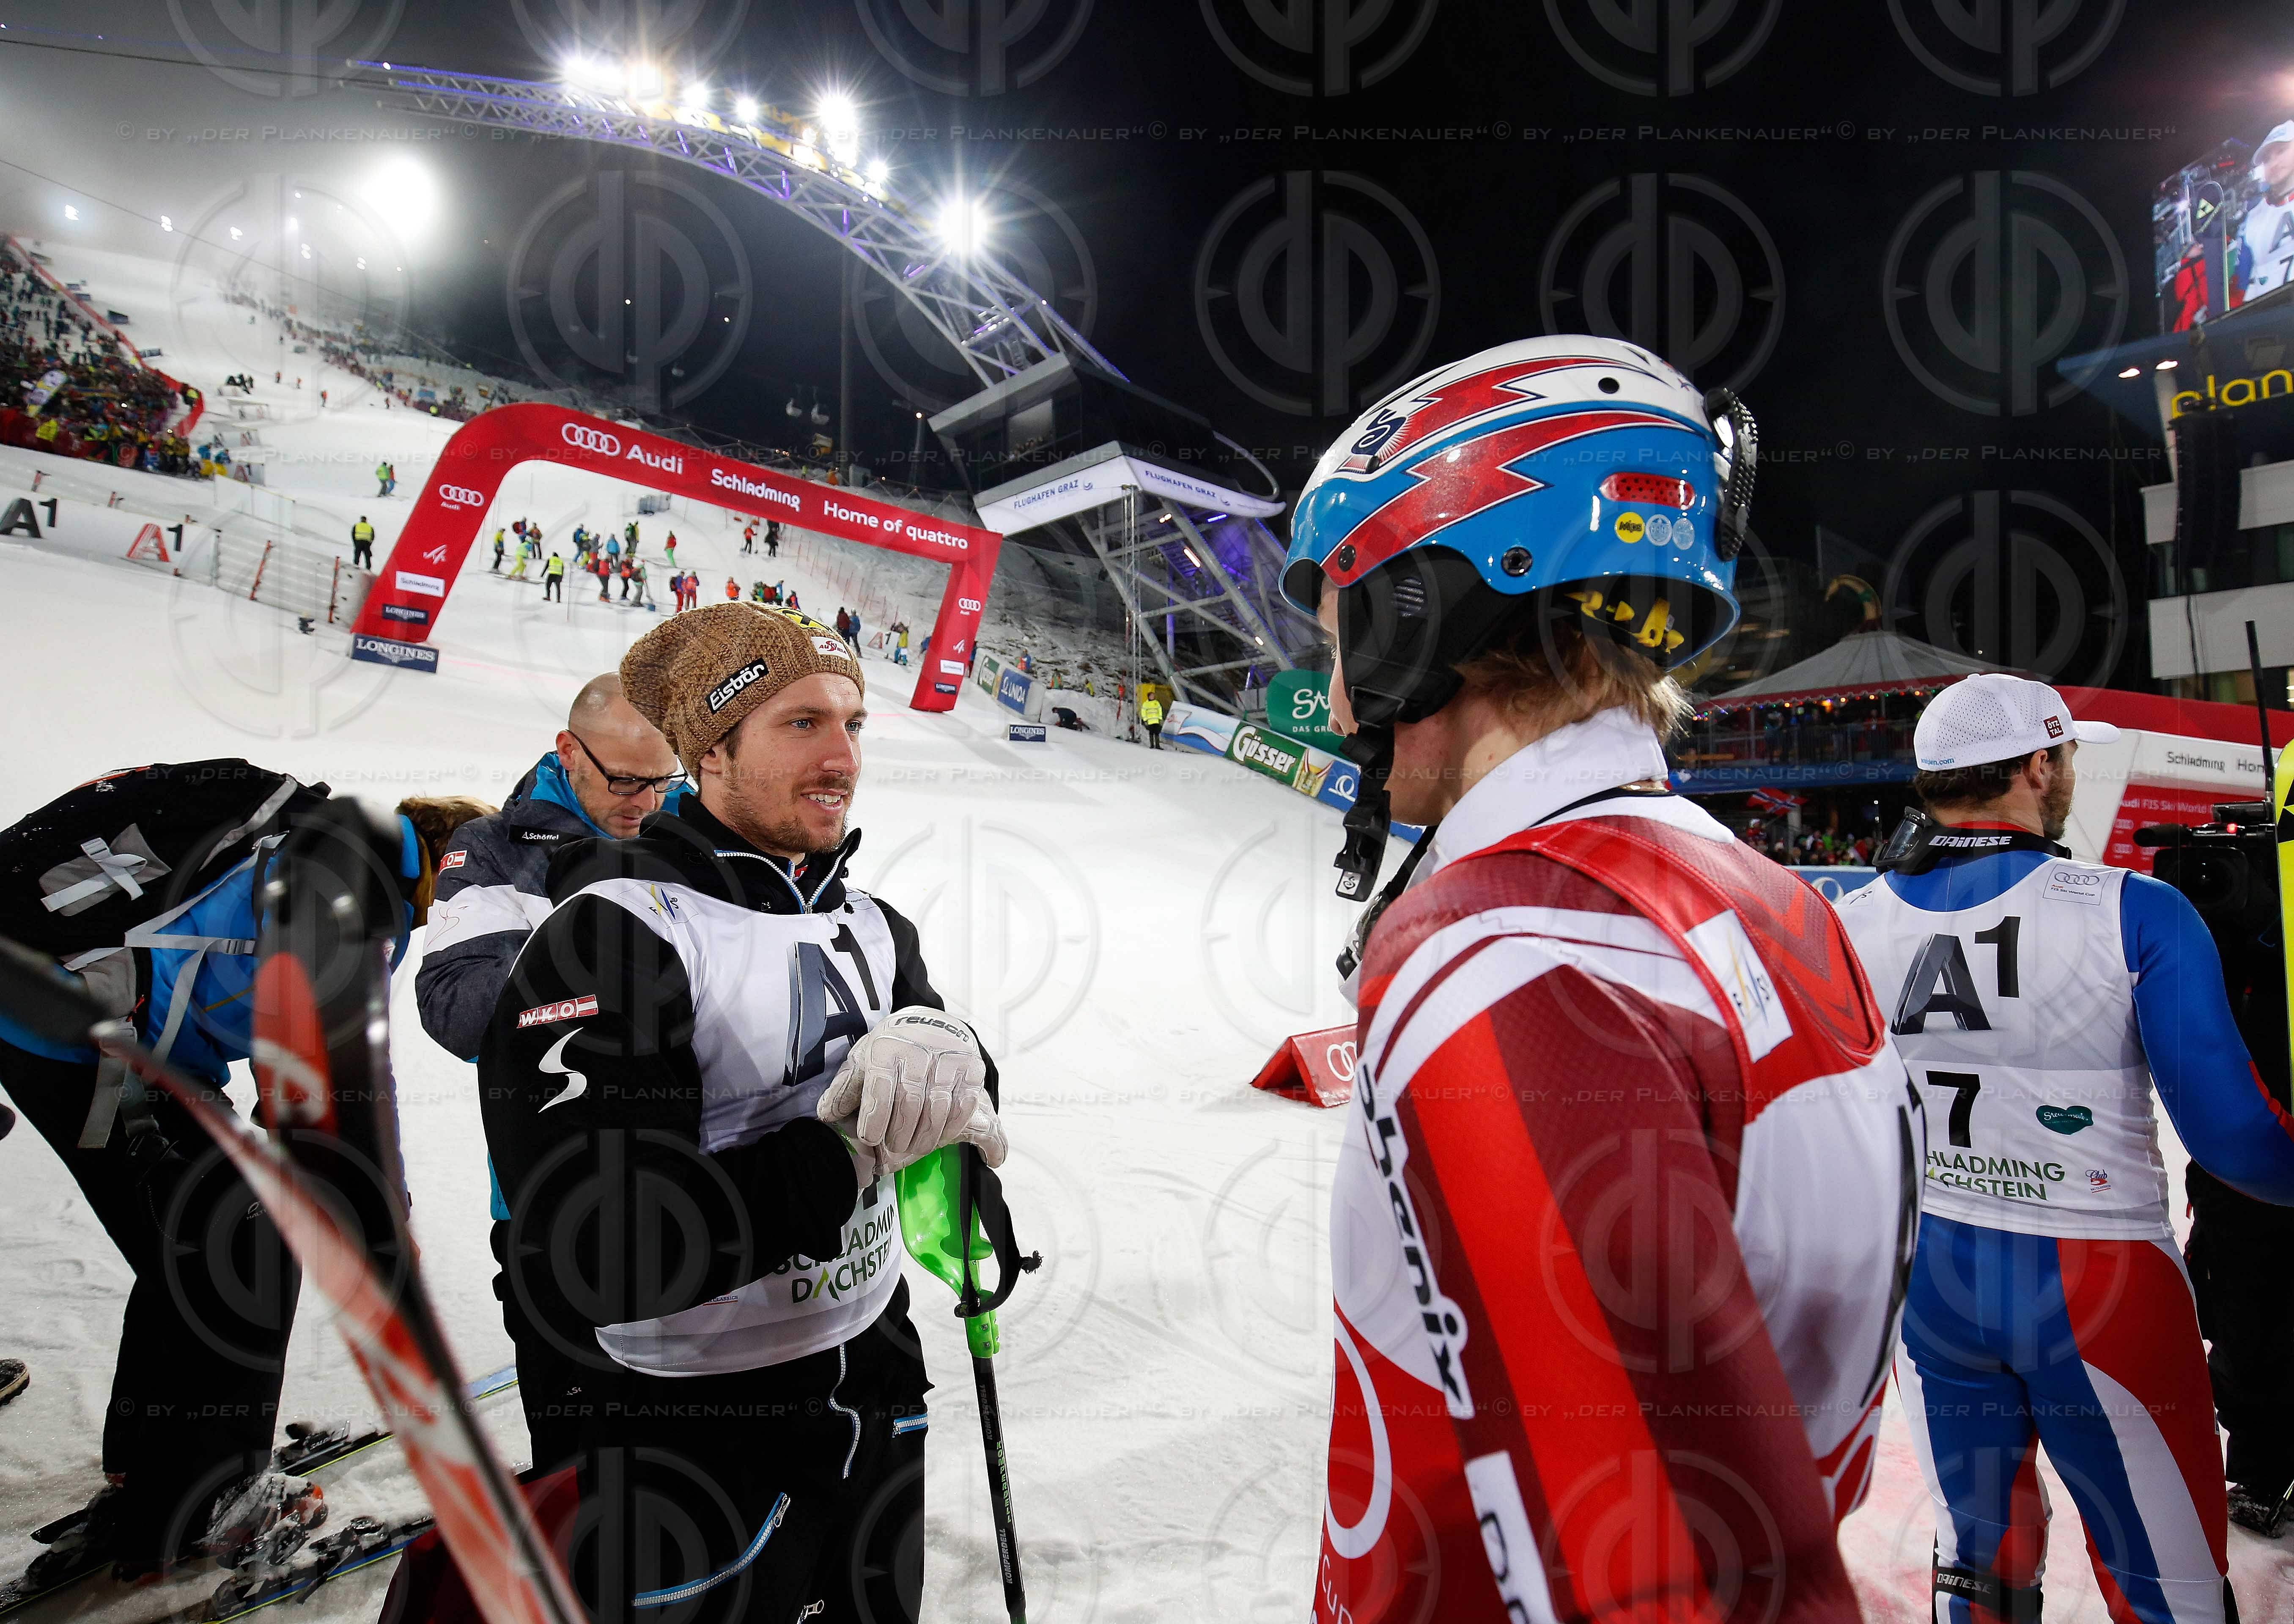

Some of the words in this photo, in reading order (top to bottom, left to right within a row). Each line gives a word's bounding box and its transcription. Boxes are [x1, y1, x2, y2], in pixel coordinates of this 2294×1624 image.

[626, 444, 683, 475] Audi
[711, 468, 801, 512] Schladming
[823, 500, 878, 529] Home
[883, 518, 903, 534] of
[906, 526, 969, 550] quattro
[1014, 489, 1055, 508] FLUGHAFEN
[1058, 480, 1079, 494] GRAZ
[1145, 470, 1193, 489] FLUGHAFEN
[1195, 486, 1216, 498] GRAZ
[0, 498, 58, 538] A1
[126, 523, 183, 562] A1
[356, 638, 436, 662] LONGINES
[710, 664, 765, 710] Eisbär
[1010, 726, 1045, 735] LONGINES
[2047, 719, 2060, 728] ÖTZ
[1232, 725, 1297, 774] Gösser
[2167, 751, 2225, 773] Schladming
[529, 832, 559, 840] Schöffel
[1891, 916, 2021, 1036] A1
[1926, 1070, 1981, 1149] 7
[996, 1440, 1011, 1523] KOMPERDELL
[999, 1528, 1013, 1584] KOMPERDELL
